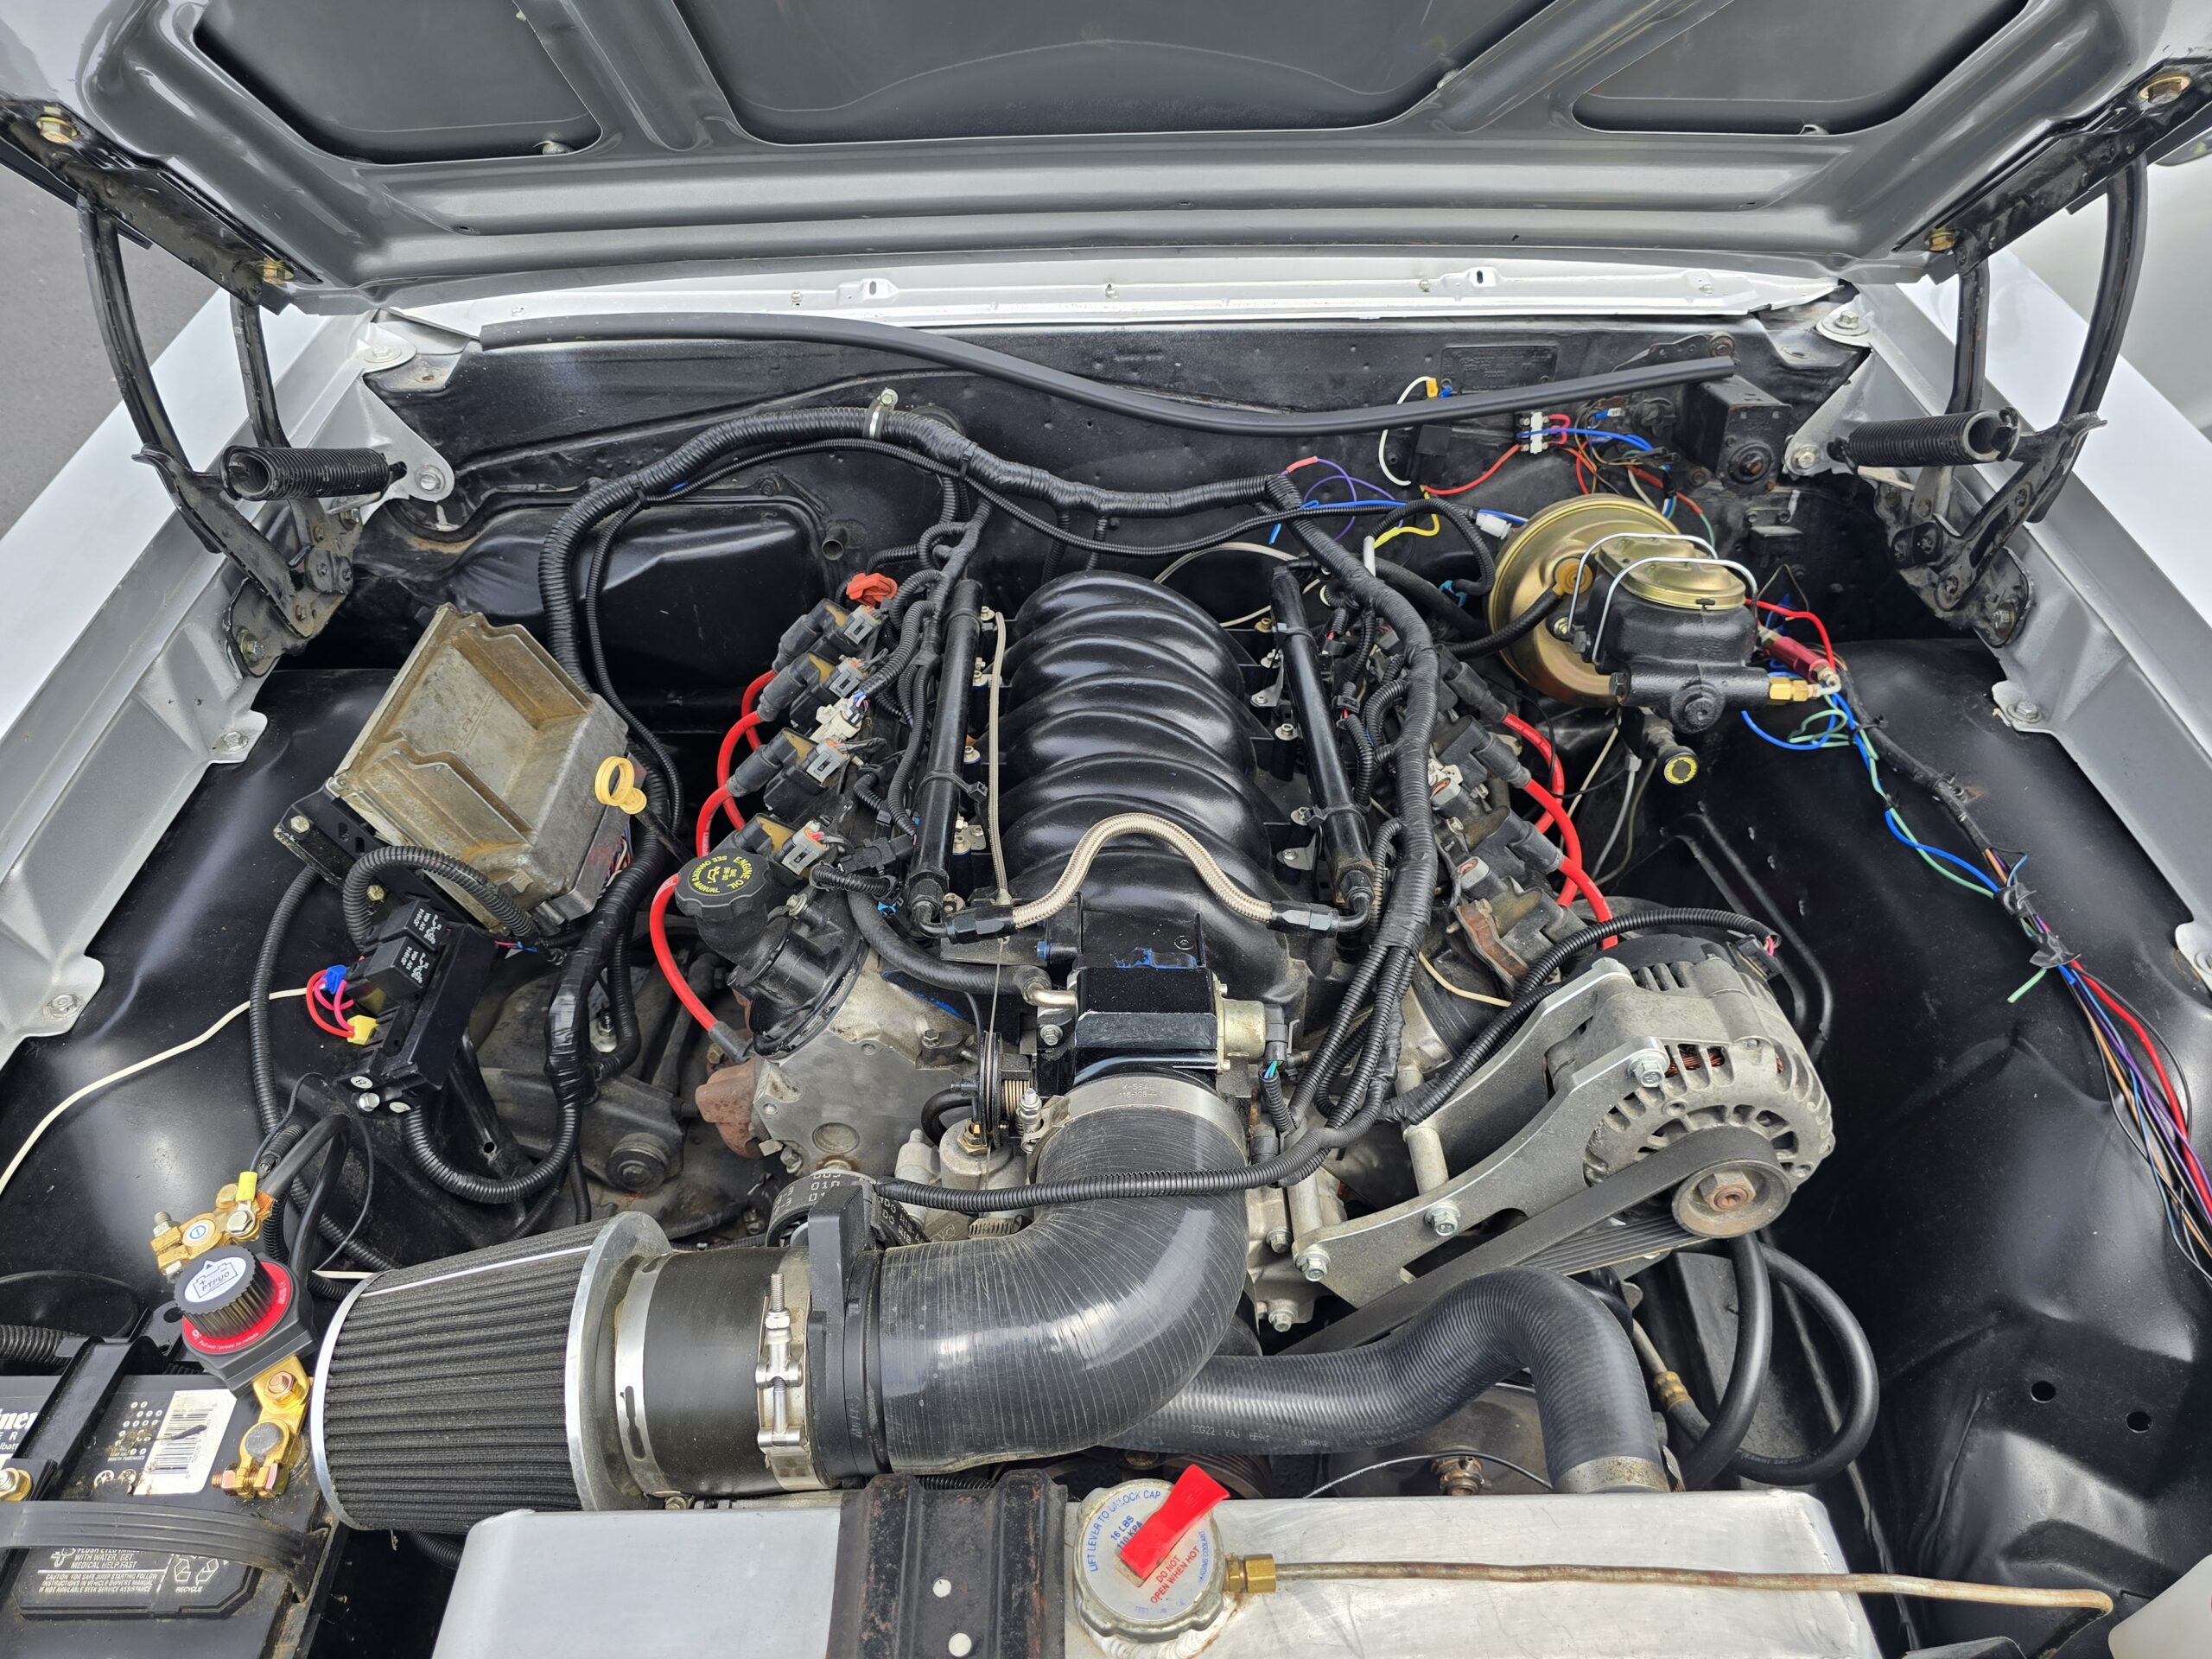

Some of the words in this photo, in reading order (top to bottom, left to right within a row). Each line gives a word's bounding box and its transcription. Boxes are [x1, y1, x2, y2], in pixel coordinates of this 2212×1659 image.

[733, 856, 753, 880] ENGINE
[693, 880, 720, 893] MANUAL
[727, 880, 744, 889] OIL
[201, 1271, 230, 1292] PTPUO
[1143, 1490, 1161, 1500] CAP
[1097, 1510, 1109, 1523] TO
[1087, 1522, 1103, 1552] LEVER
[1110, 1530, 1121, 1541] 16
[1122, 1515, 1135, 1533] LBS
[1087, 1554, 1098, 1573] LIFT
[1155, 1570, 1167, 1583] DO
[1166, 1554, 1180, 1573] NOT
[1150, 1582, 1170, 1604] OPEN
[1167, 1561, 1188, 1584] WHEN
[1185, 1546, 1200, 1566] HOT
